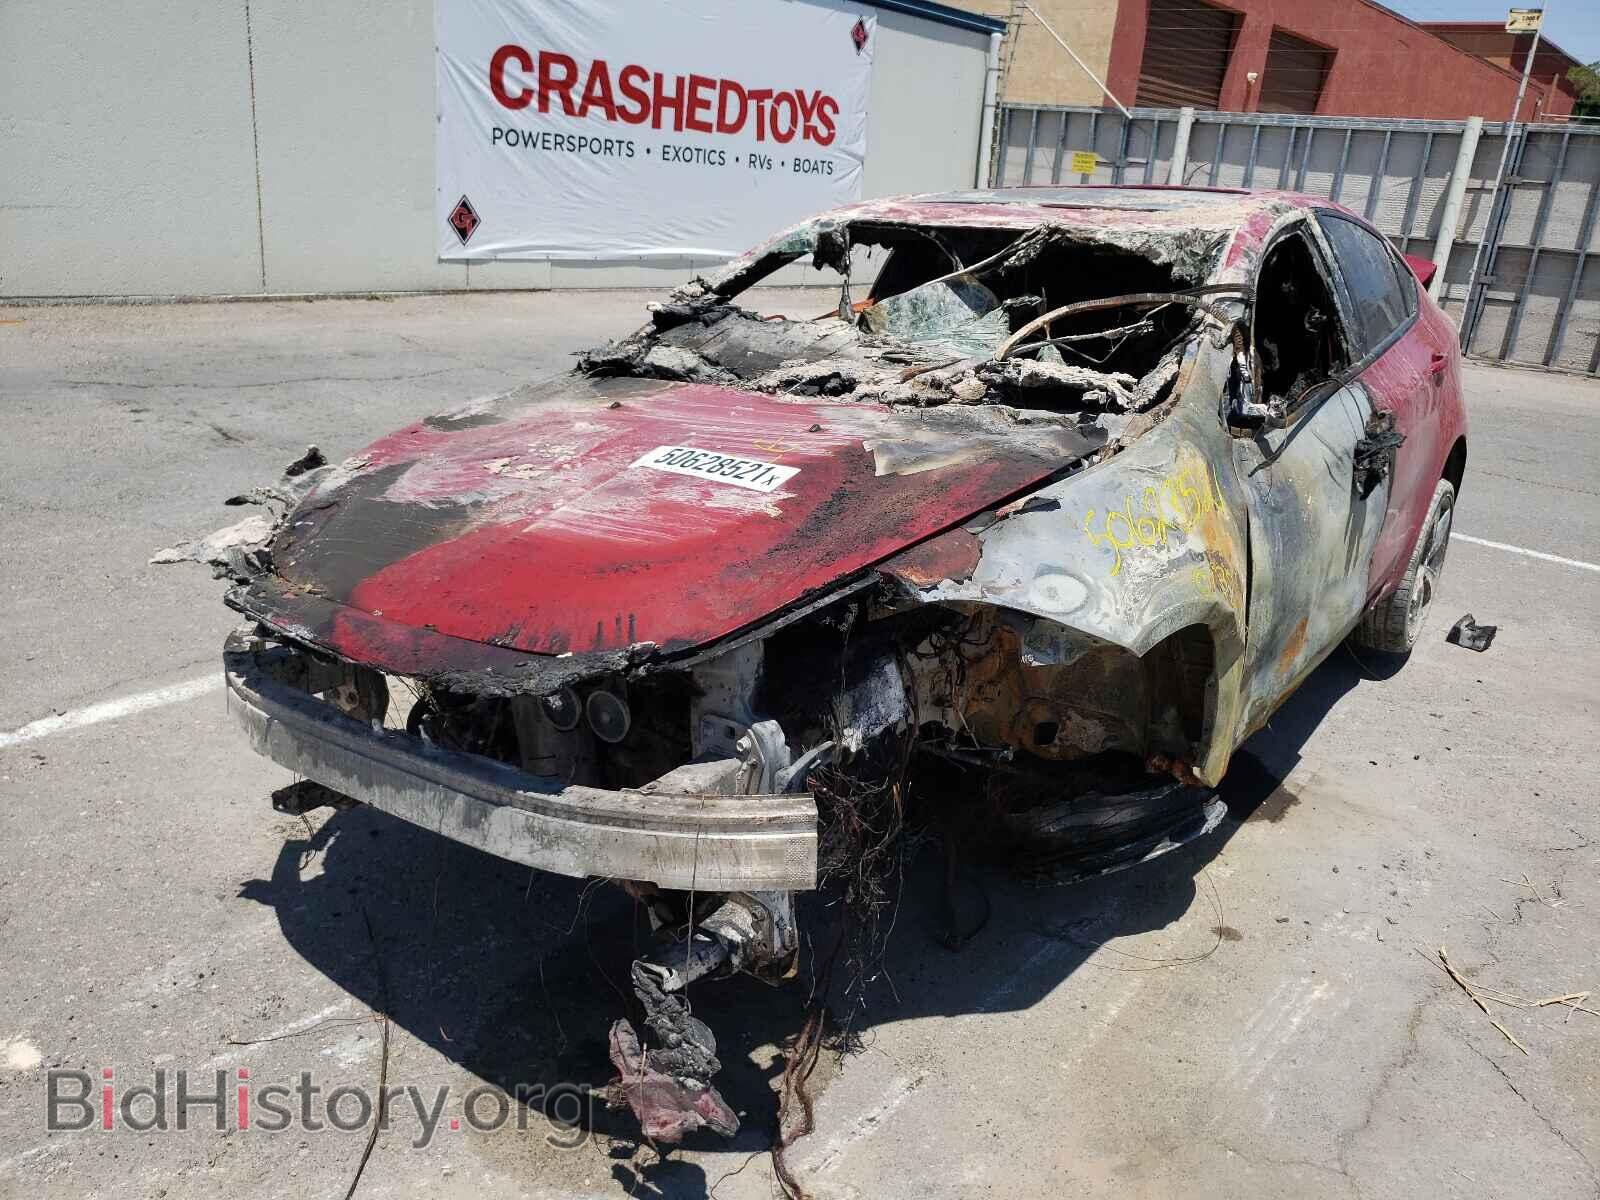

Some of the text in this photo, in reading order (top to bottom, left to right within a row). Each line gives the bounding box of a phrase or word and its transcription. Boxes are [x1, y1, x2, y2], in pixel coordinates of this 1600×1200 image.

[492, 126, 834, 176] POWERSPORTS EXOTICS RVs BOATS
